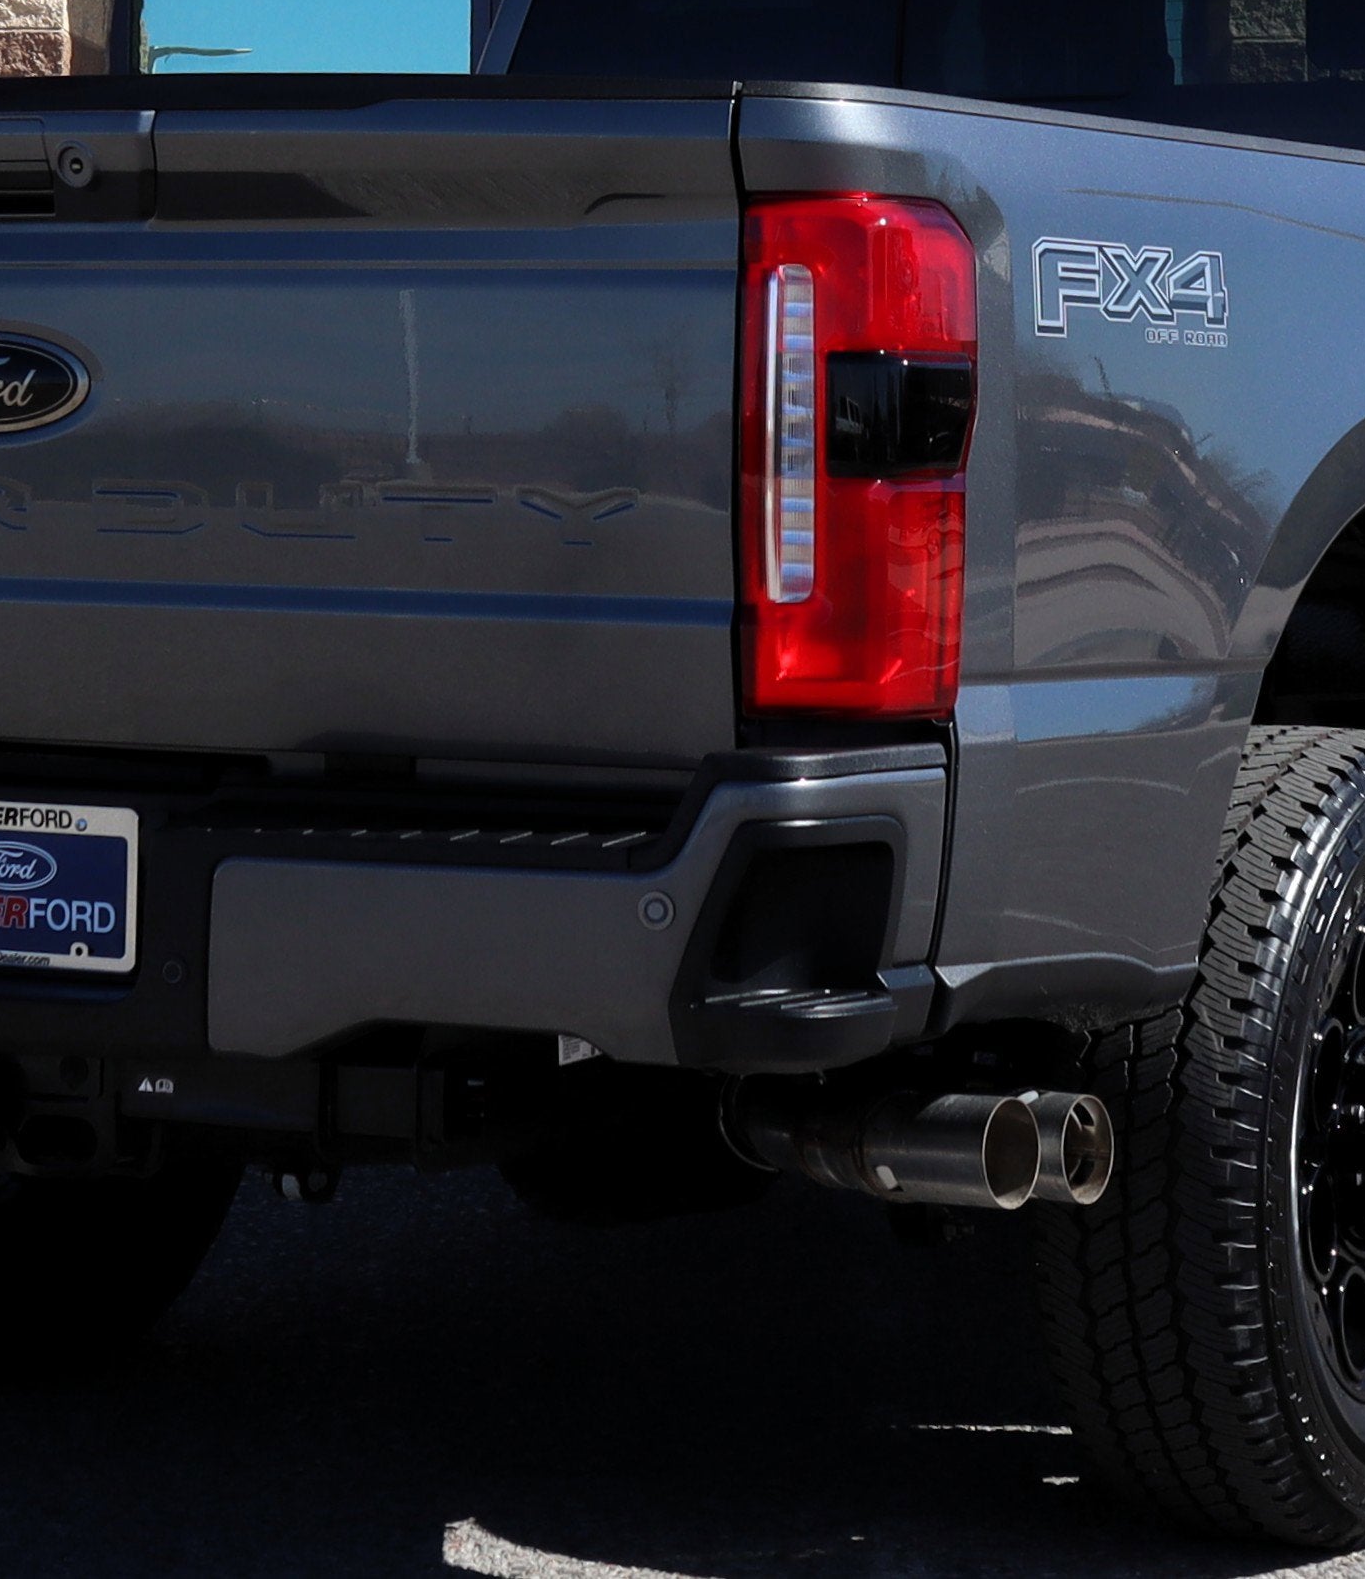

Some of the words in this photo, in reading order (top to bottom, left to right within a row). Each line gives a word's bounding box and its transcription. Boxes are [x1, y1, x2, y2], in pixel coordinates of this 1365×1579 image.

[1031, 235, 1230, 339] FX4
[1144, 326, 1180, 345] OFF
[1183, 329, 1229, 348] ROAD
[91, 478, 640, 547] DUTY
